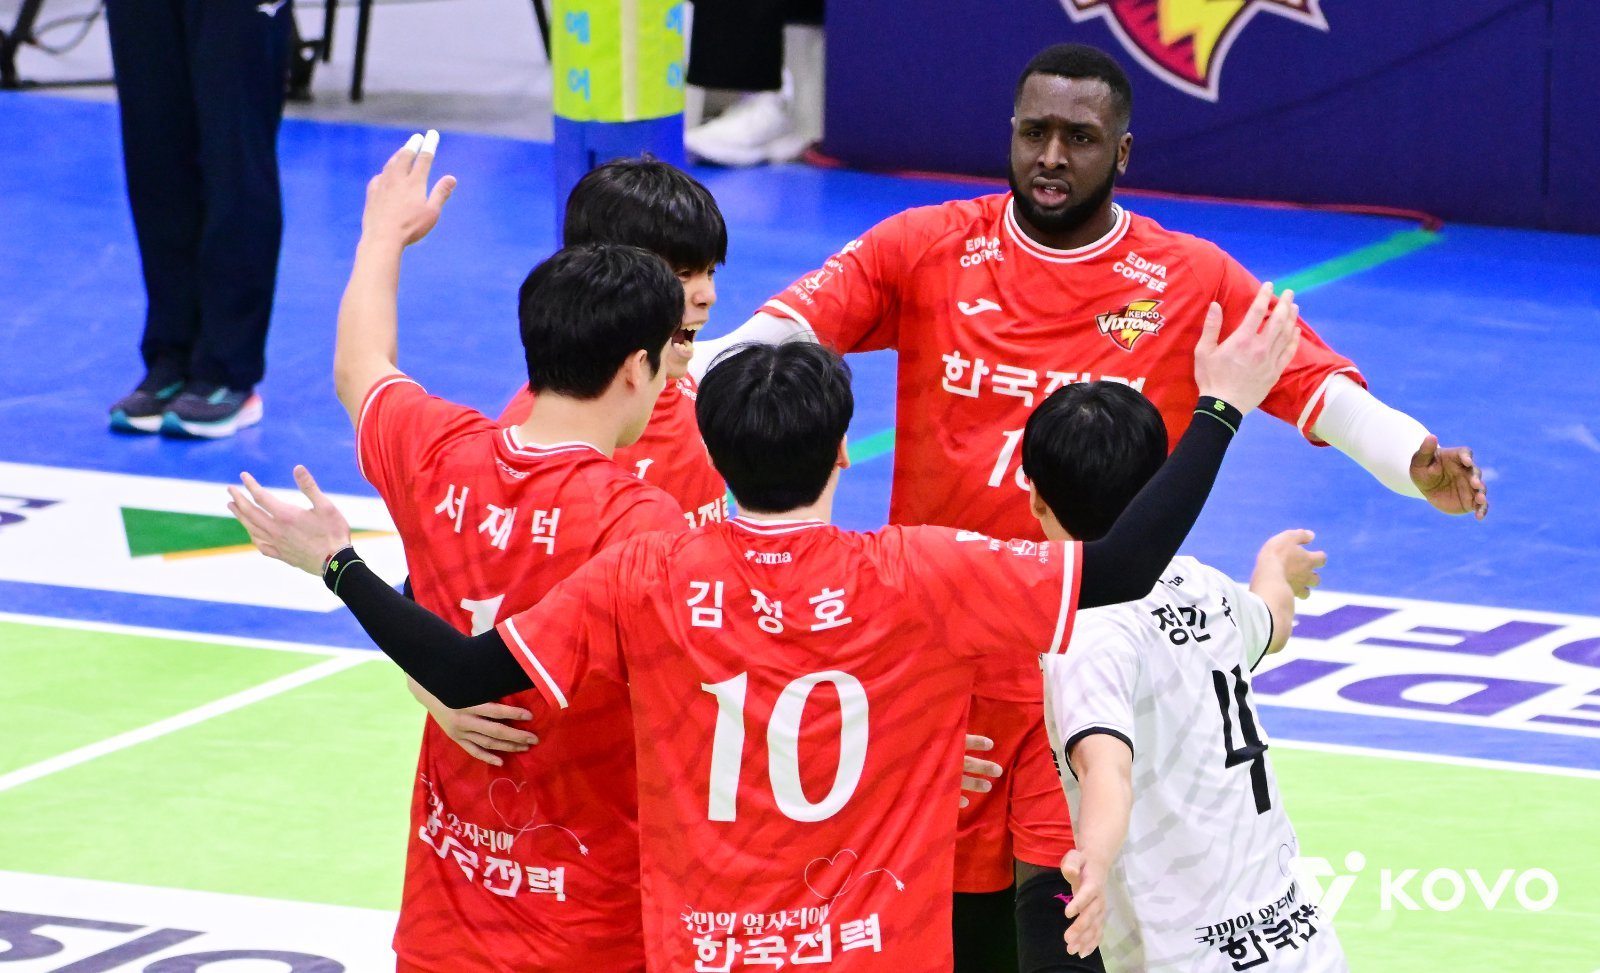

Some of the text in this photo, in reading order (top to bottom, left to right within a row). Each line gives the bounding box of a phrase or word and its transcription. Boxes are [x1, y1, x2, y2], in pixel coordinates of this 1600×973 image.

[1112, 261, 1168, 293] COFFEE
[1125, 251, 1167, 279] EDIYA
[1128, 310, 1160, 319] KEPCO
[987, 427, 1031, 492] 1
[434, 483, 561, 555] 서재덕
[686, 580, 853, 634] 김정호
[700, 670, 869, 823] 10
[1212, 663, 1269, 815] 4
[692, 913, 882, 973] 한국전력
[1219, 903, 1321, 972] 한국전
